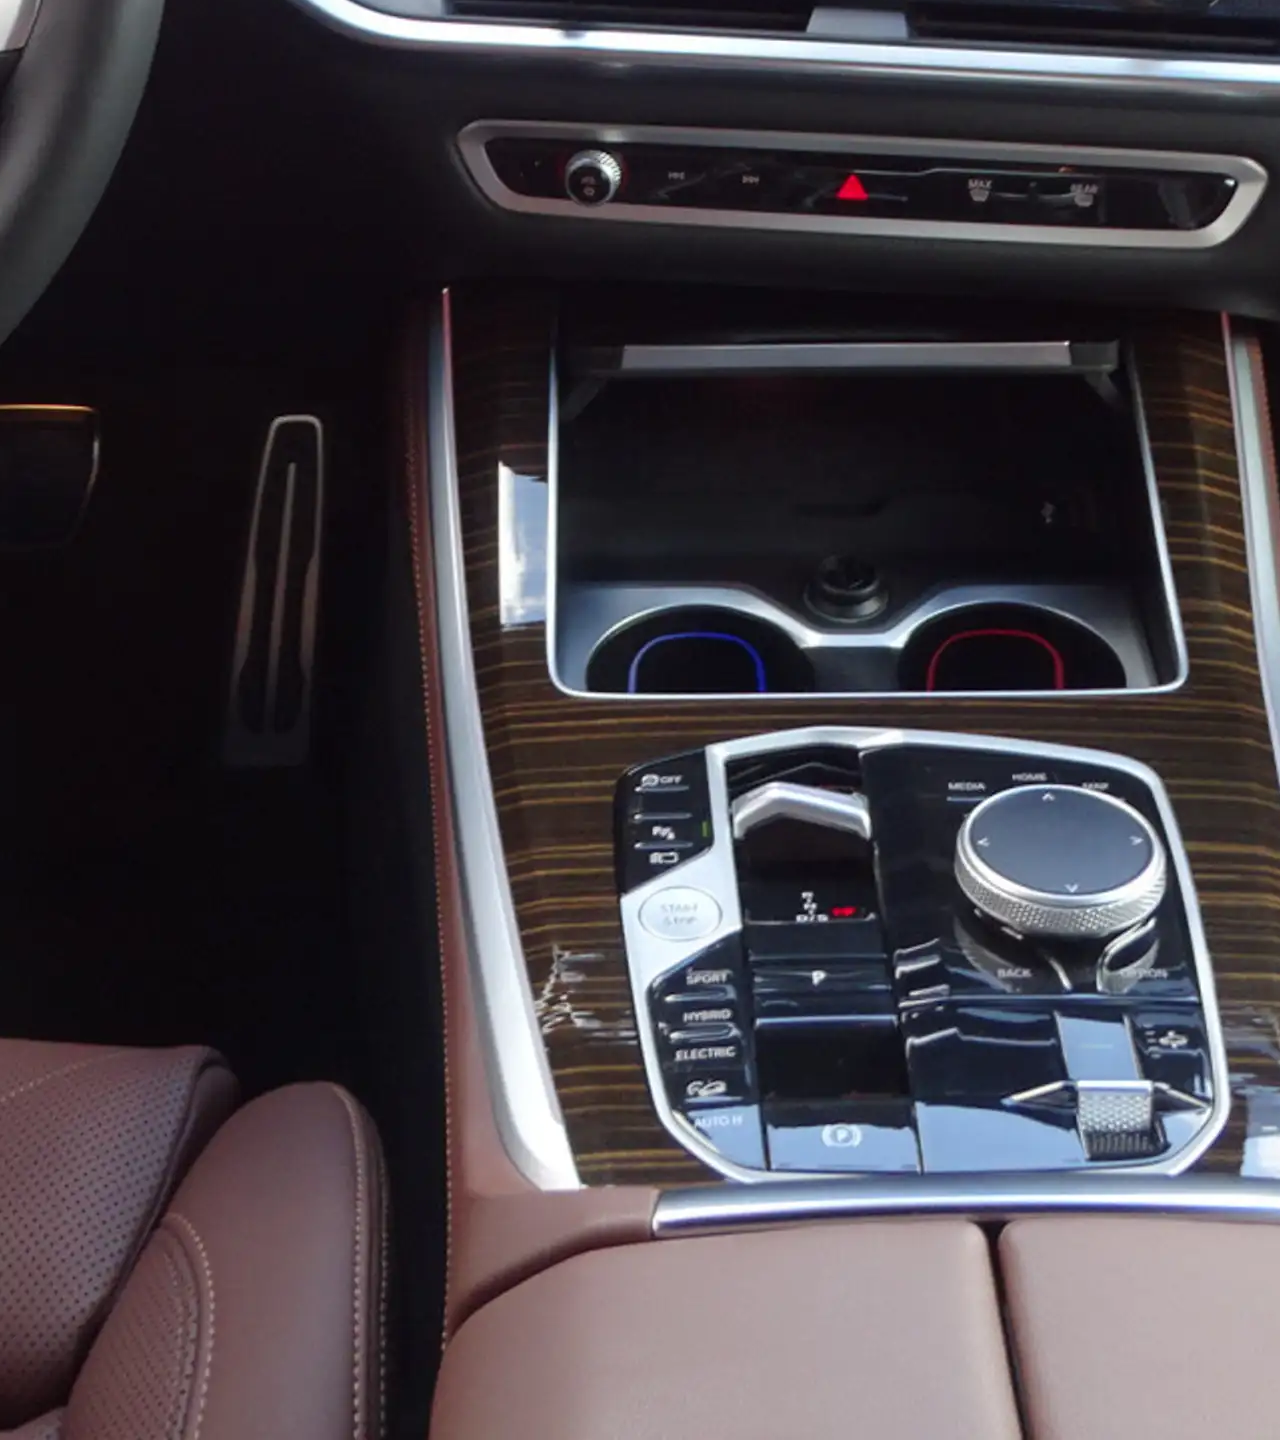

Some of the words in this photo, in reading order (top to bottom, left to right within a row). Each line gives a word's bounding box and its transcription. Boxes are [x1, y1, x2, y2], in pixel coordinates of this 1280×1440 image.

[1011, 772, 1048, 782] HOME
[948, 781, 987, 792] MEDIA
[660, 902, 699, 914] START
[686, 971, 732, 986] SPORT
[811, 969, 827, 988] P
[997, 967, 1033, 979] BACK
[682, 1008, 733, 1022] HYBRID
[674, 1045, 737, 1062] ELECTRIC
[694, 1114, 730, 1128] AUTO
